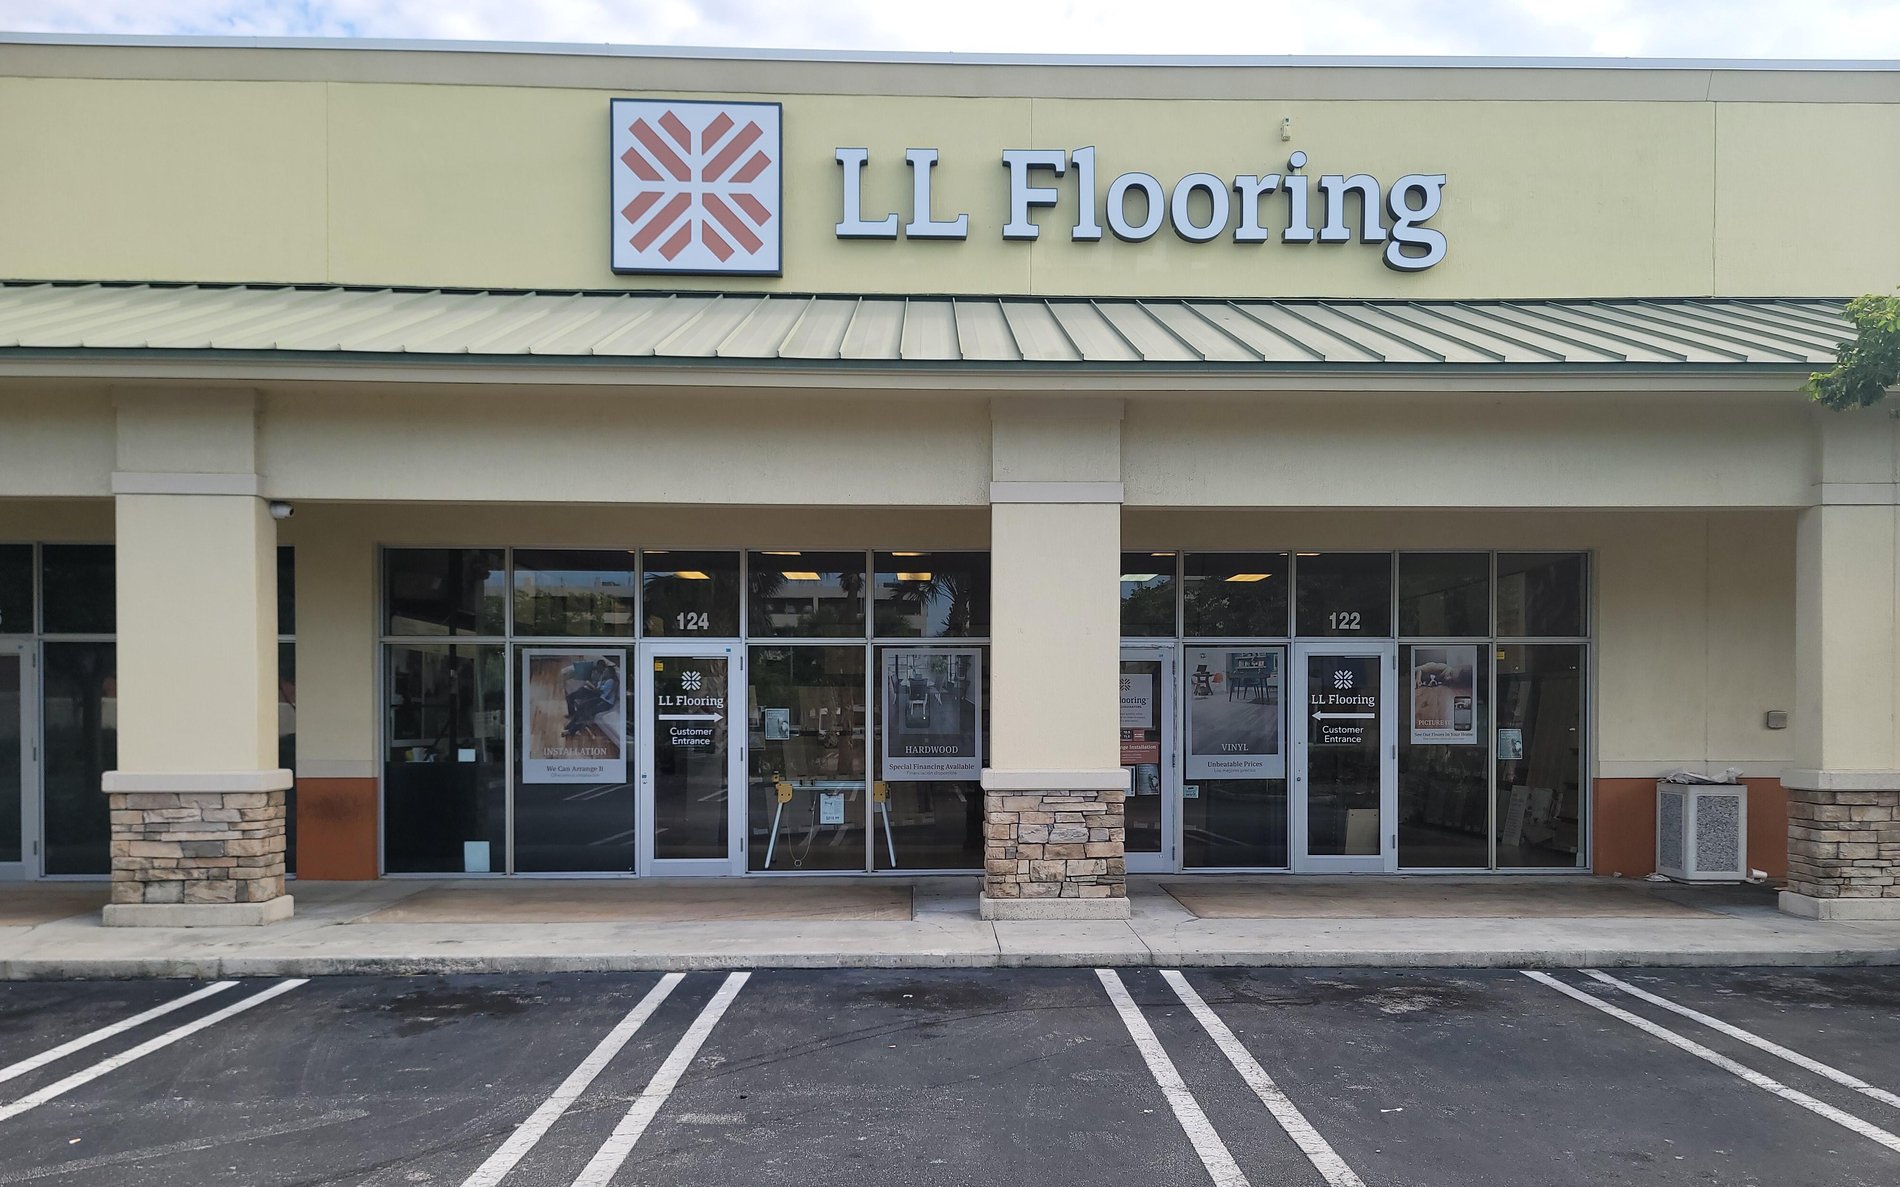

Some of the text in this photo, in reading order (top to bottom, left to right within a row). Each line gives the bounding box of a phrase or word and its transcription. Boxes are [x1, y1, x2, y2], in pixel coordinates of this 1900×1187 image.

[834, 144, 1448, 271] LL Flooring
[676, 612, 710, 630] 124
[1329, 612, 1361, 630] 122
[658, 695, 724, 708] LL Flooring
[1311, 694, 1376, 708] LL Flooring
[669, 726, 713, 736] Customer
[1322, 725, 1364, 734] Customer
[671, 736, 711, 746] Entrance
[1324, 734, 1362, 743] Entrance
[543, 747, 607, 756] INSTALLATION
[905, 745, 959, 754] HARDWOOD
[1221, 743, 1249, 751] VINYL
[889, 763, 912, 771] Special
[913, 763, 945, 771] Financing
[1207, 760, 1242, 768] Unbeatable
[572, 765, 598, 773] Arrange
